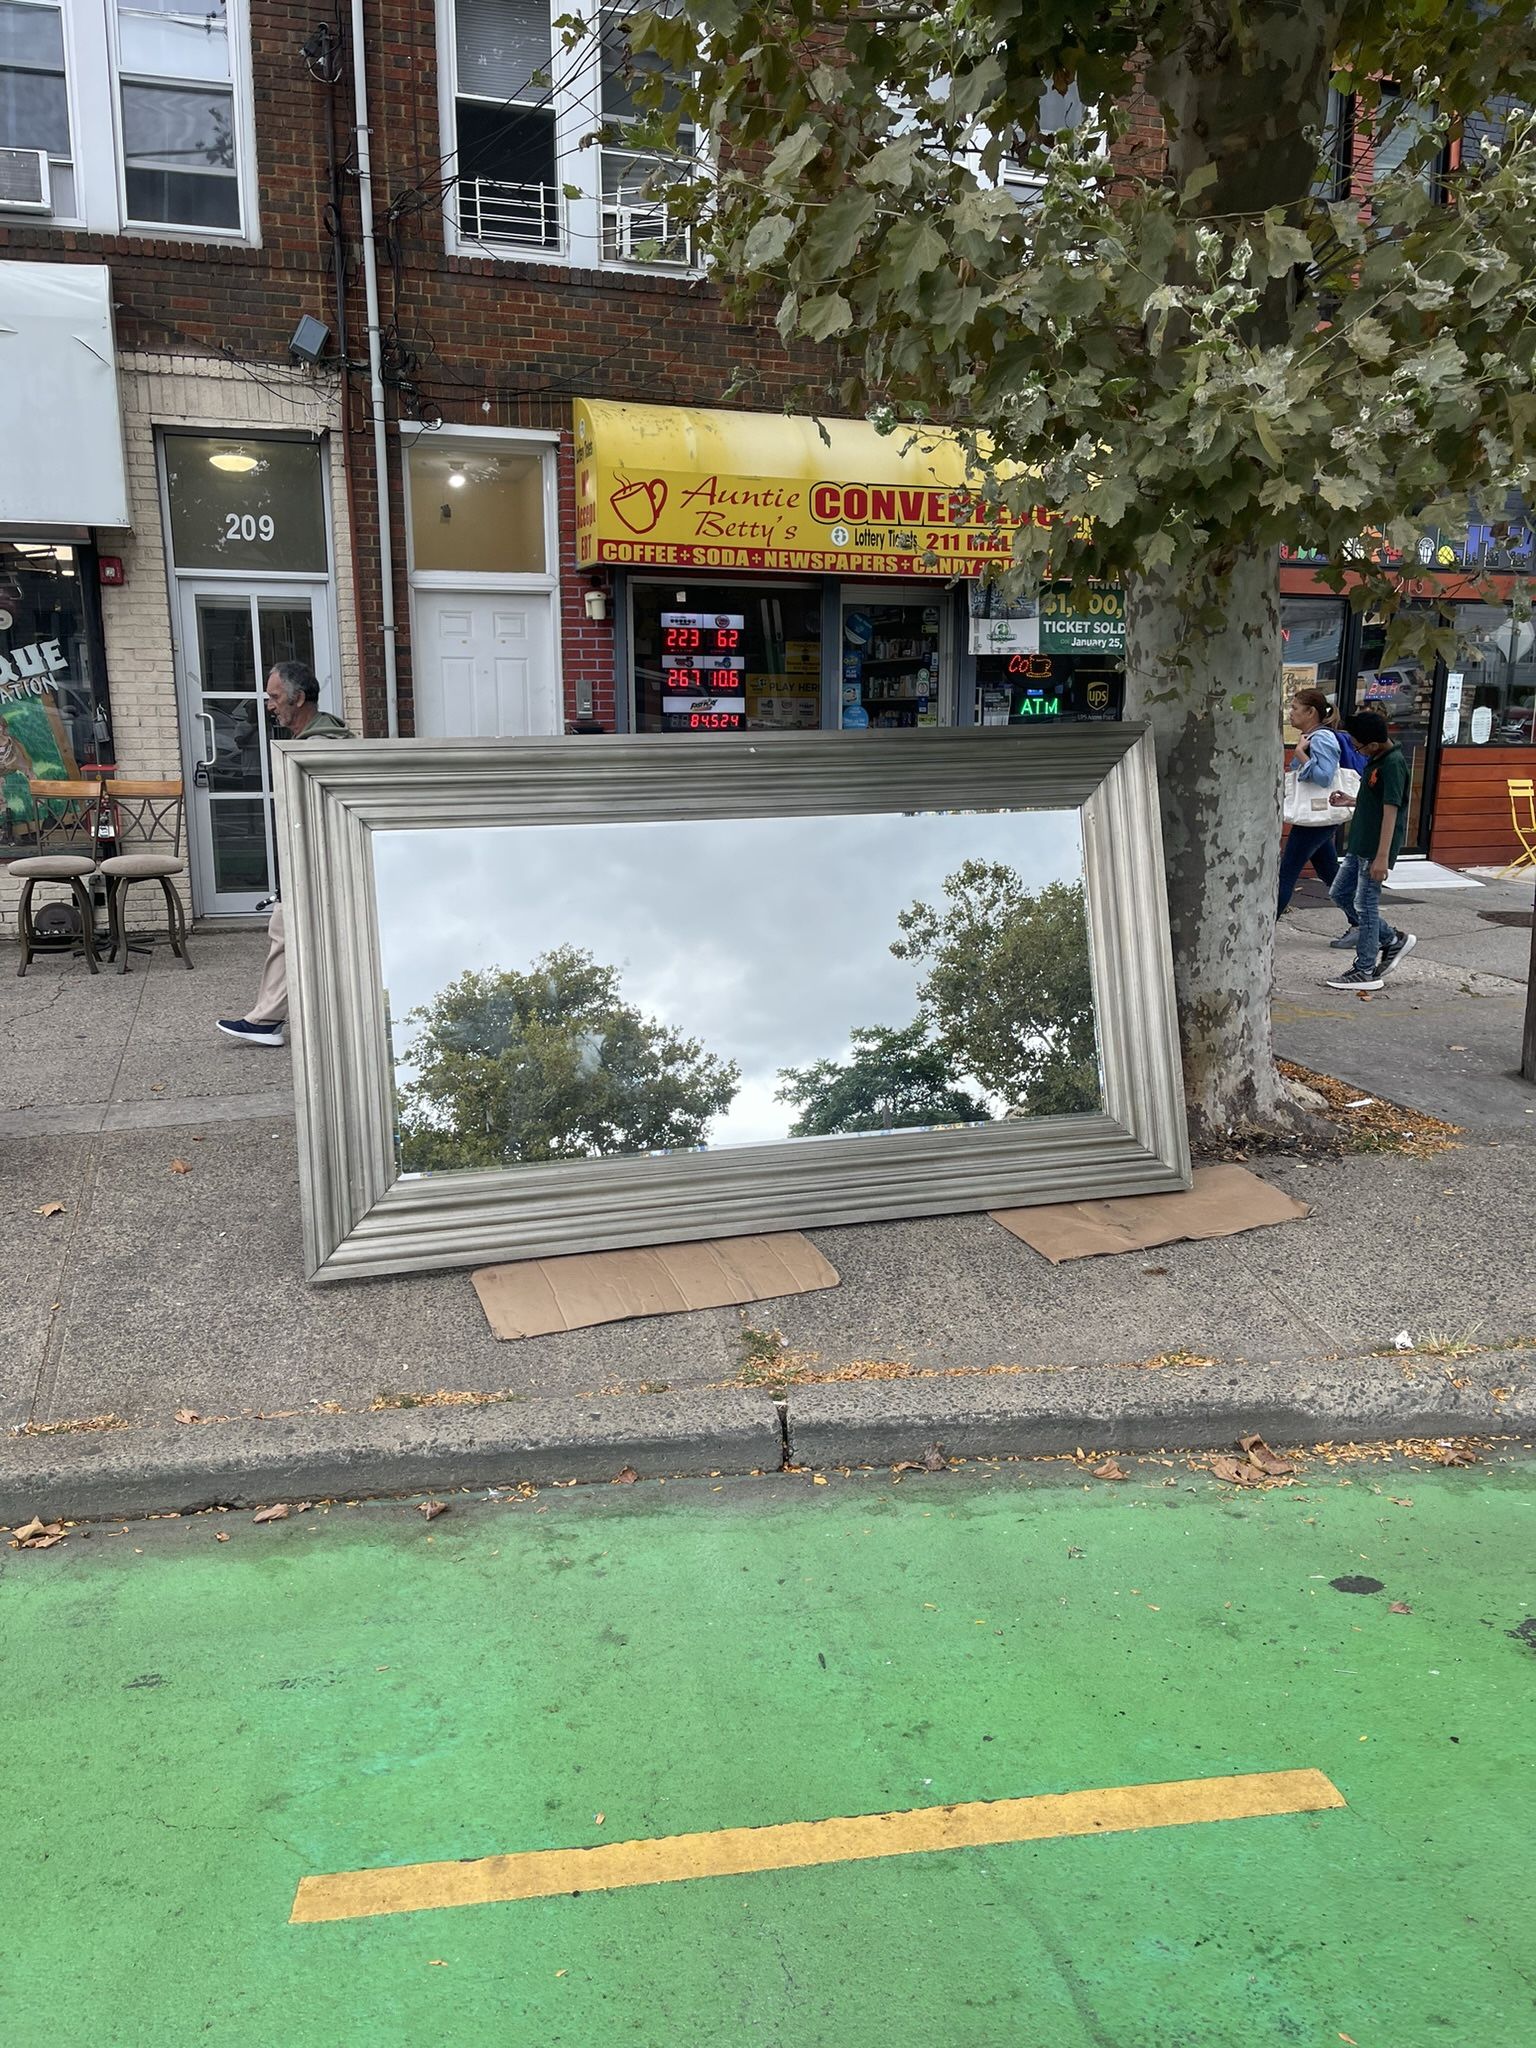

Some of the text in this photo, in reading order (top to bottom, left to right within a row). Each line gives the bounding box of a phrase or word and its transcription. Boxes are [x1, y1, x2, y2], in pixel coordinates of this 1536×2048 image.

[680, 475, 800, 509] Auntie
[225, 513, 275, 543] 209
[695, 511, 798, 548] Betty's
[854, 528, 885, 551] Lottery
[926, 532, 960, 551] 211
[602, 542, 678, 563] COFFEE
[692, 548, 750, 567] SODA
[764, 551, 898, 573] NEWSPAPERS
[1043, 621, 1126, 634] TICKET SOLD
[667, 628, 739, 648] 223 62
[1071, 637, 1106, 648] January
[1108, 638, 1123, 648] 25,
[668, 669, 700, 687] 267
[769, 682, 795, 691] PLAY
[798, 683, 819, 692] HER
[1020, 698, 1059, 715] ATM
